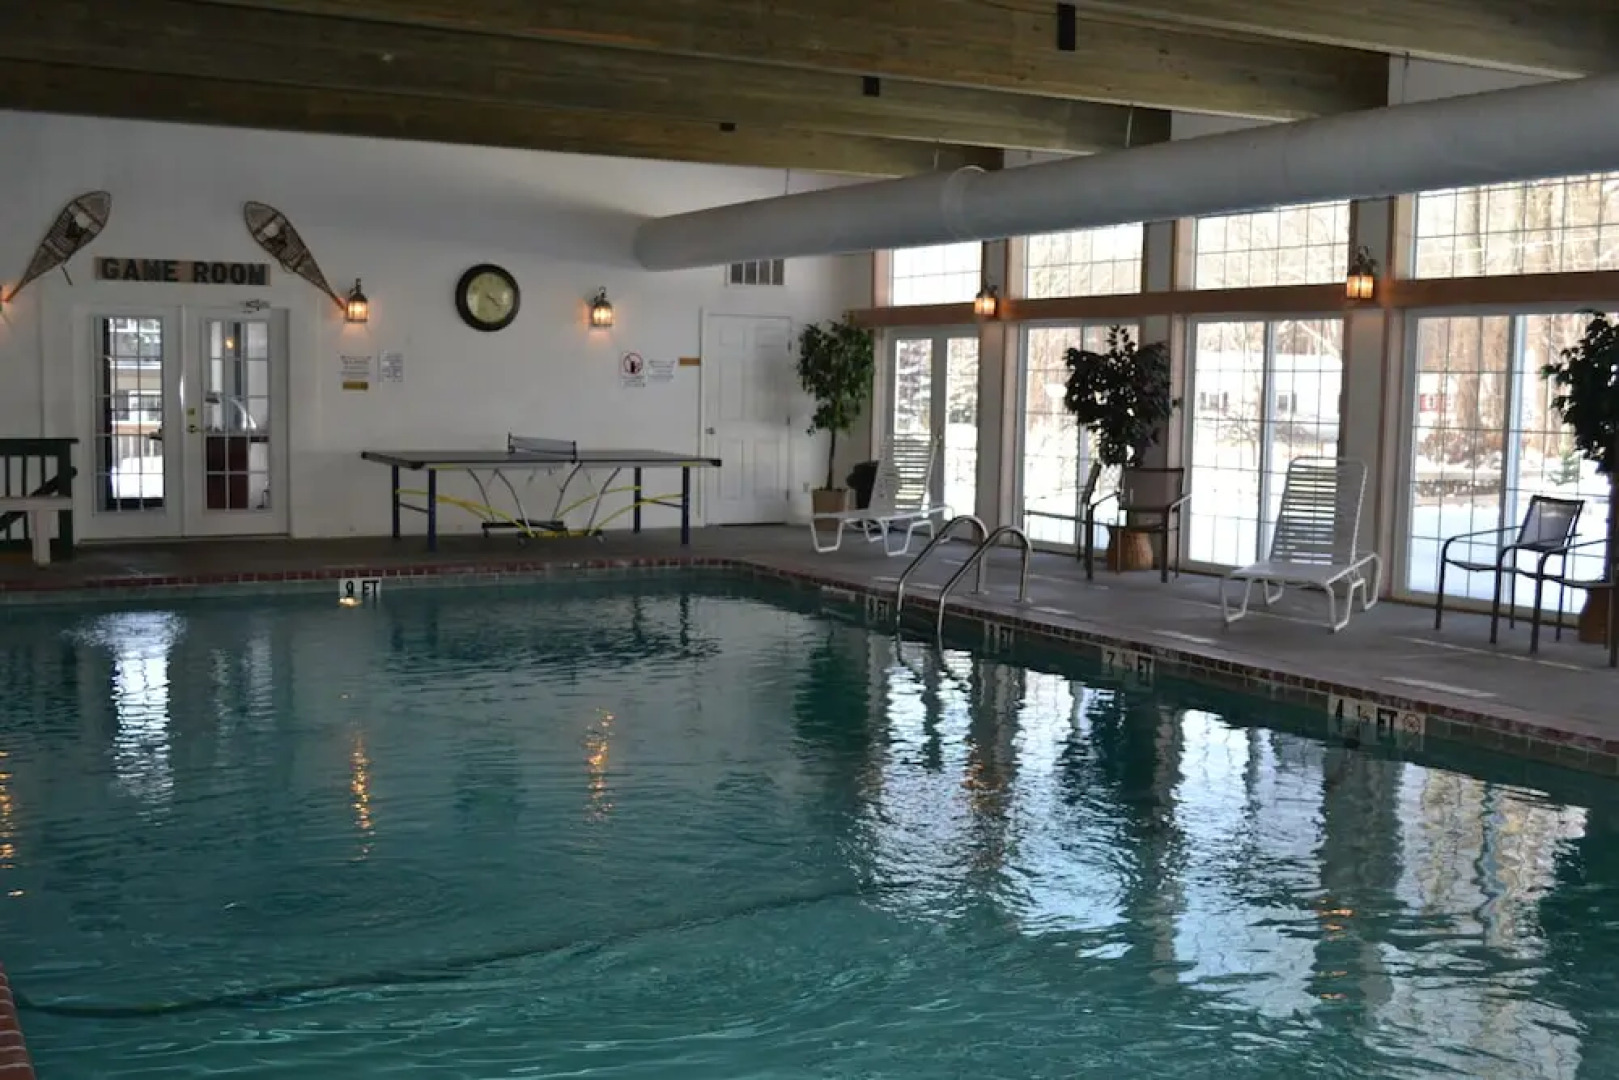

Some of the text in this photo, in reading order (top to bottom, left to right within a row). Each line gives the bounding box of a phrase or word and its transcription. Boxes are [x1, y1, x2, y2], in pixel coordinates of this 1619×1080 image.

[101, 258, 266, 285] GAME ROOM
[362, 580, 380, 597] FT
[1377, 708, 1398, 728] FT
